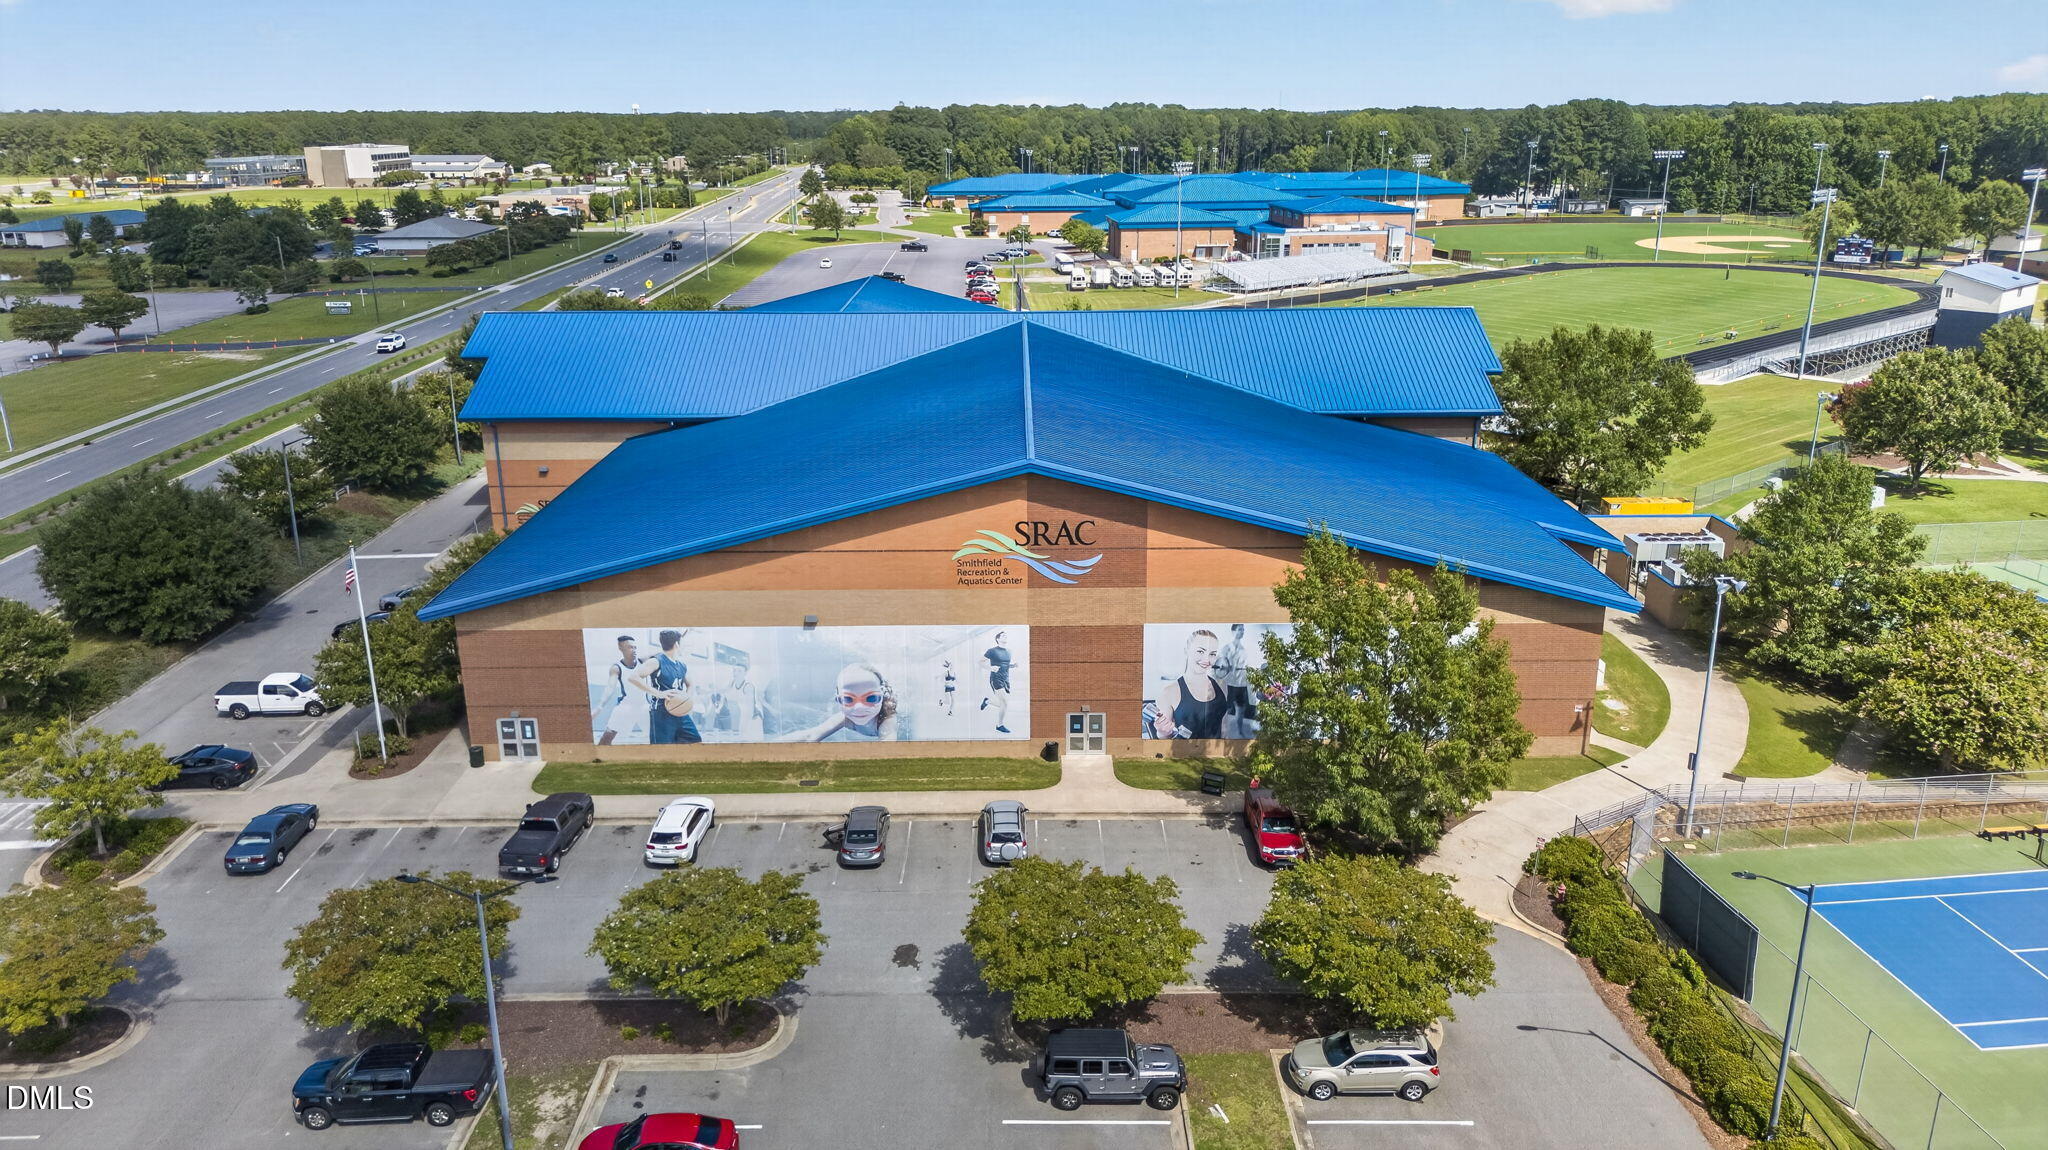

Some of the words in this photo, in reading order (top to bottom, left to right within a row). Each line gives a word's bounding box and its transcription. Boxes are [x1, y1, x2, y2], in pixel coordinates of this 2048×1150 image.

[1014, 519, 1096, 546] SRAC
[956, 558, 1002, 567] Smithfield
[957, 568, 1001, 576] Recreation
[1003, 567, 1010, 576] &
[958, 577, 993, 586] Aquatics
[995, 577, 1023, 585] Center
